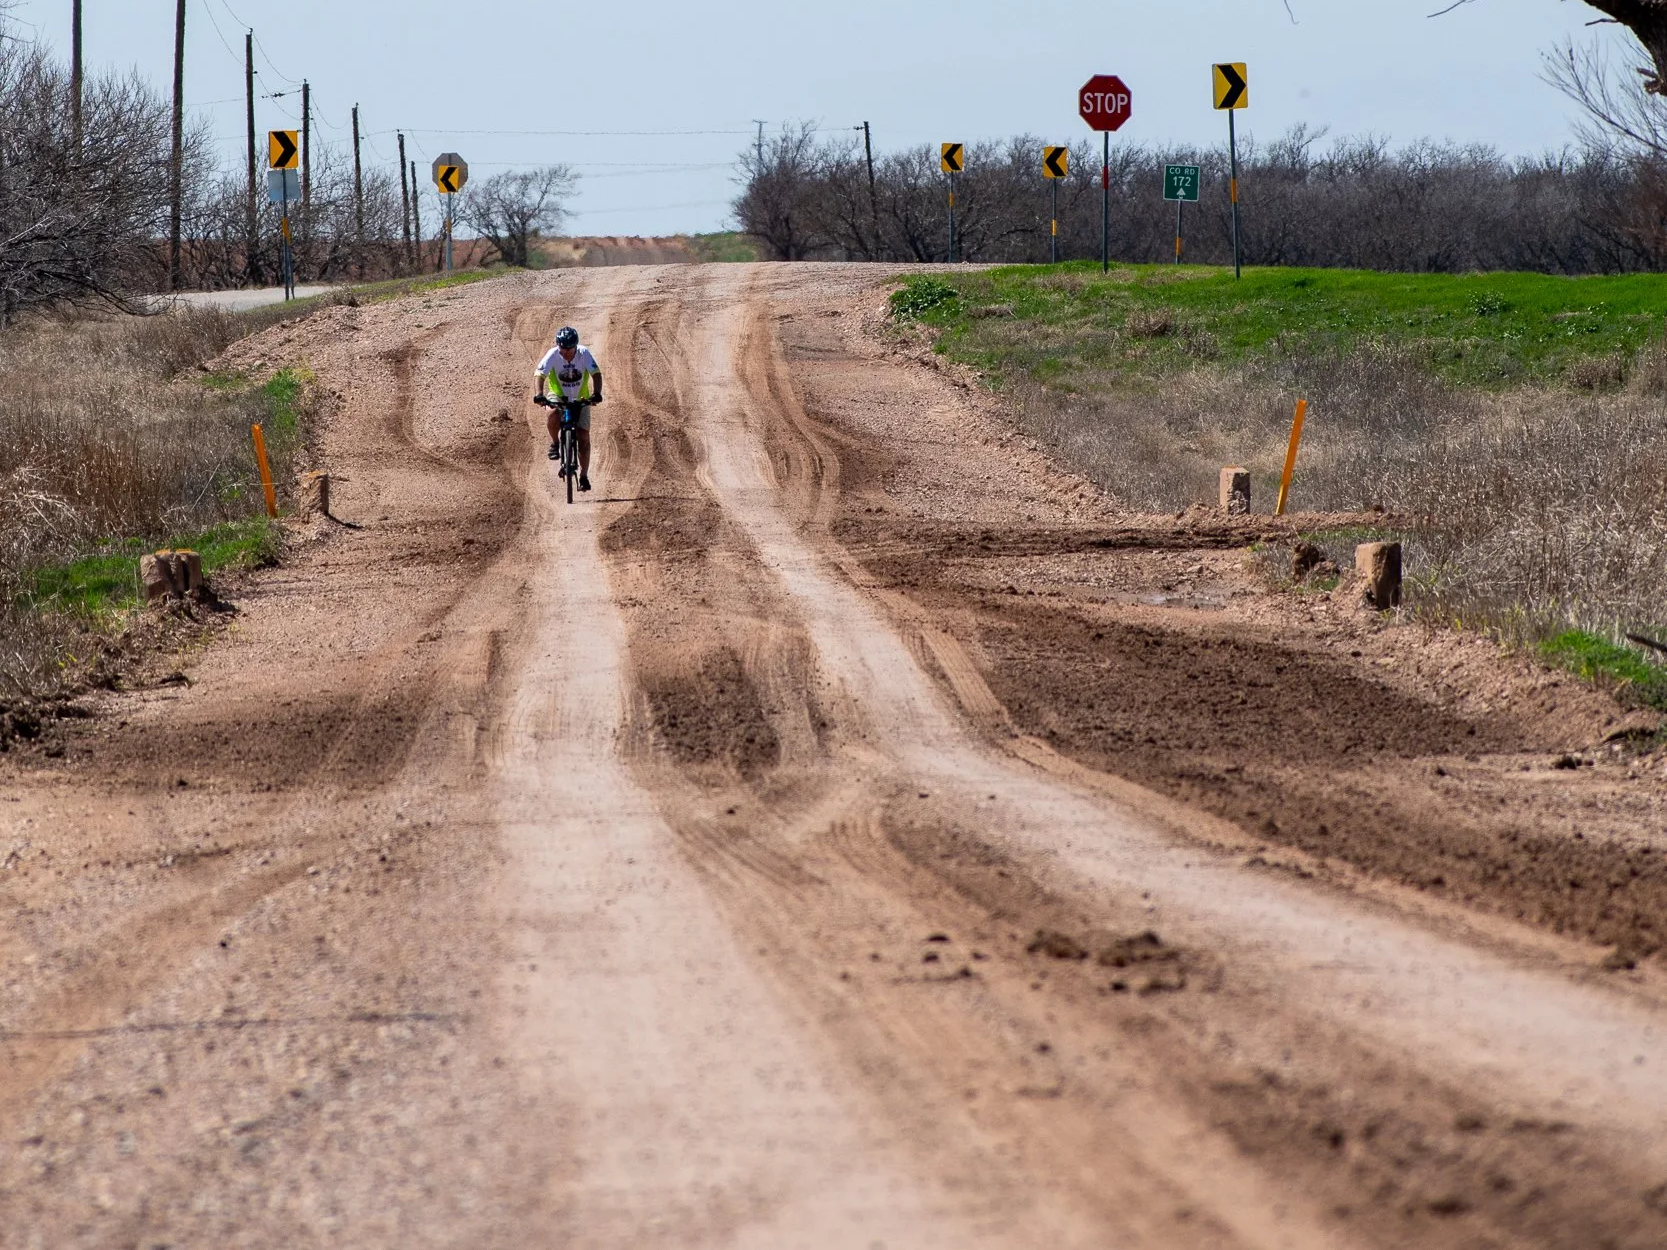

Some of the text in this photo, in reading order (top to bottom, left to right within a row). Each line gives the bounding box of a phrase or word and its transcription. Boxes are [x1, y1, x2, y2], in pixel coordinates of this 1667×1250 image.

[1082, 92, 1128, 114] STOP
[1169, 167, 1181, 175] CO
[1173, 176, 1192, 187] 172
